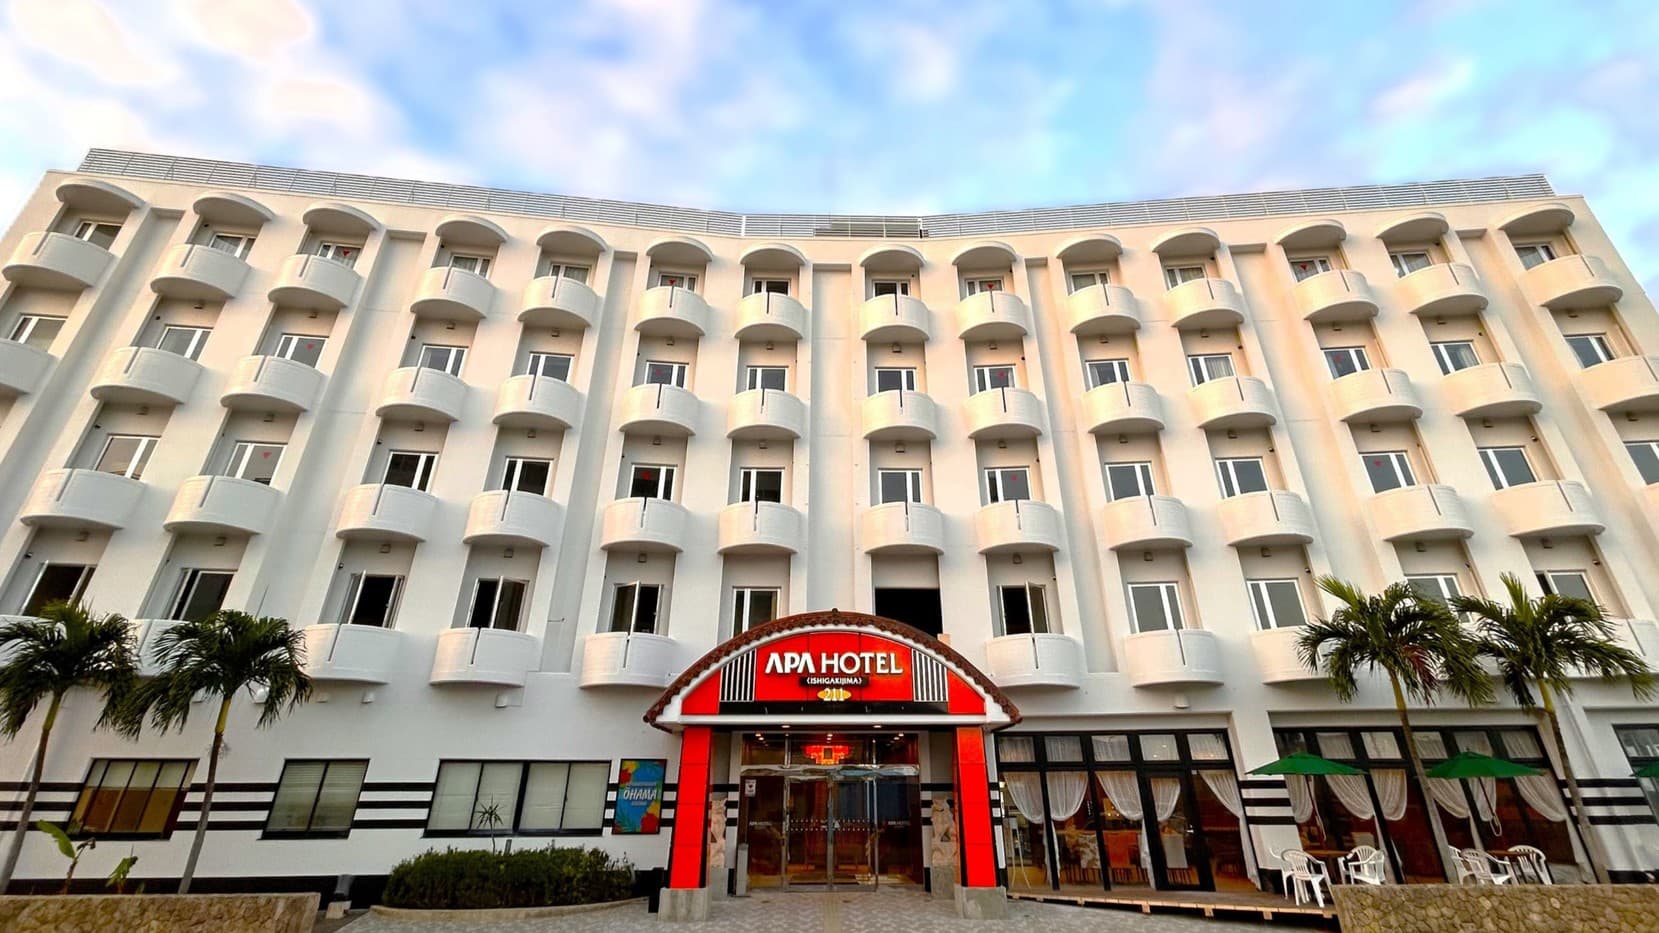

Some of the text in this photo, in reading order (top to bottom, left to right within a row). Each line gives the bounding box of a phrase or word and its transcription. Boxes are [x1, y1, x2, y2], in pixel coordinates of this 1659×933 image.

[765, 652, 904, 674] APA HOTEL
[823, 688, 844, 702] 211
